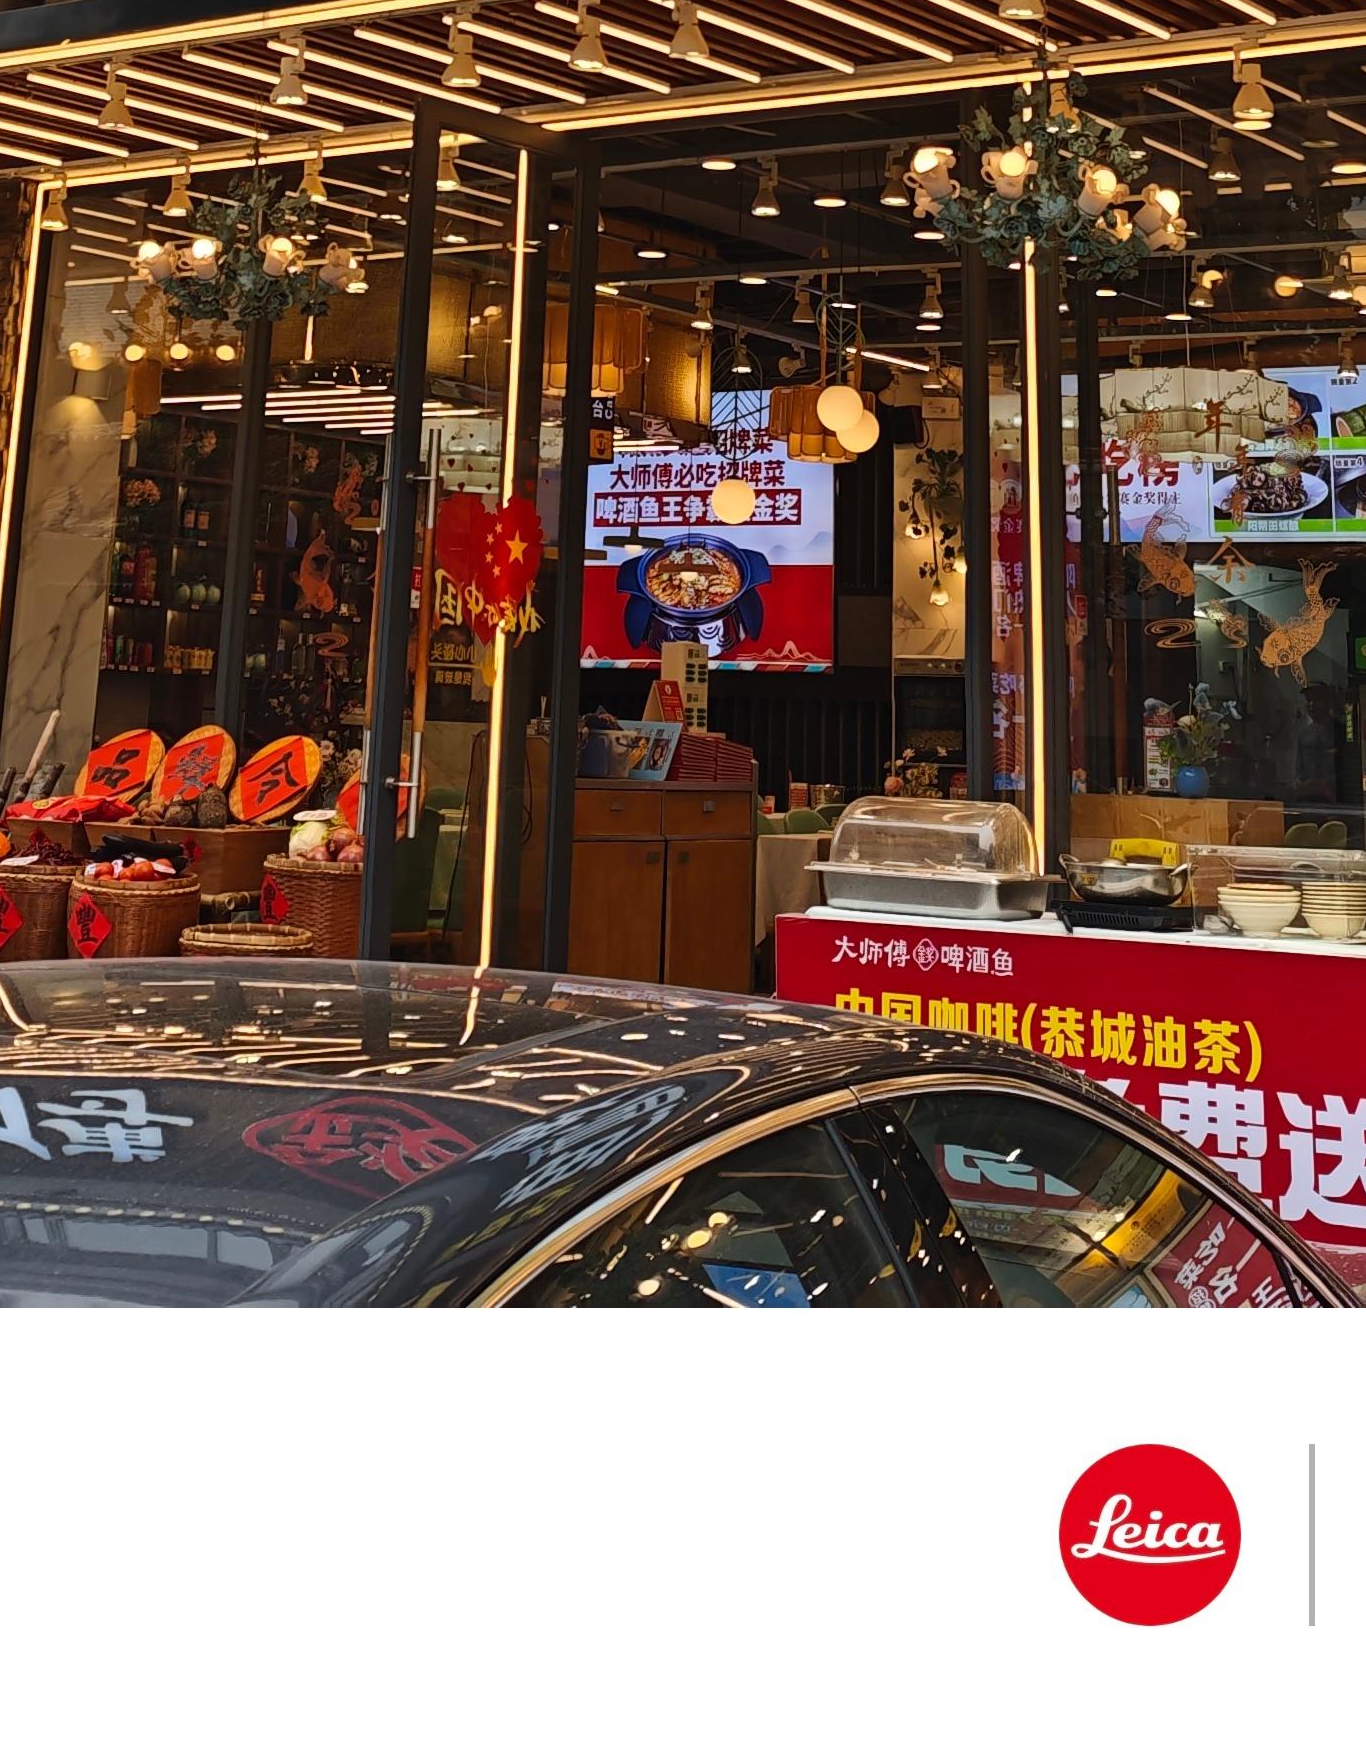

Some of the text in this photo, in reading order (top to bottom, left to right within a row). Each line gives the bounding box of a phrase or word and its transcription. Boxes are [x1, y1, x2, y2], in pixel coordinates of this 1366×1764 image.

[609, 458, 787, 491] 大师傅必吃招牌菜
[831, 935, 911, 968] 大师傅
[940, 943, 1014, 977] 啤酒鱼
